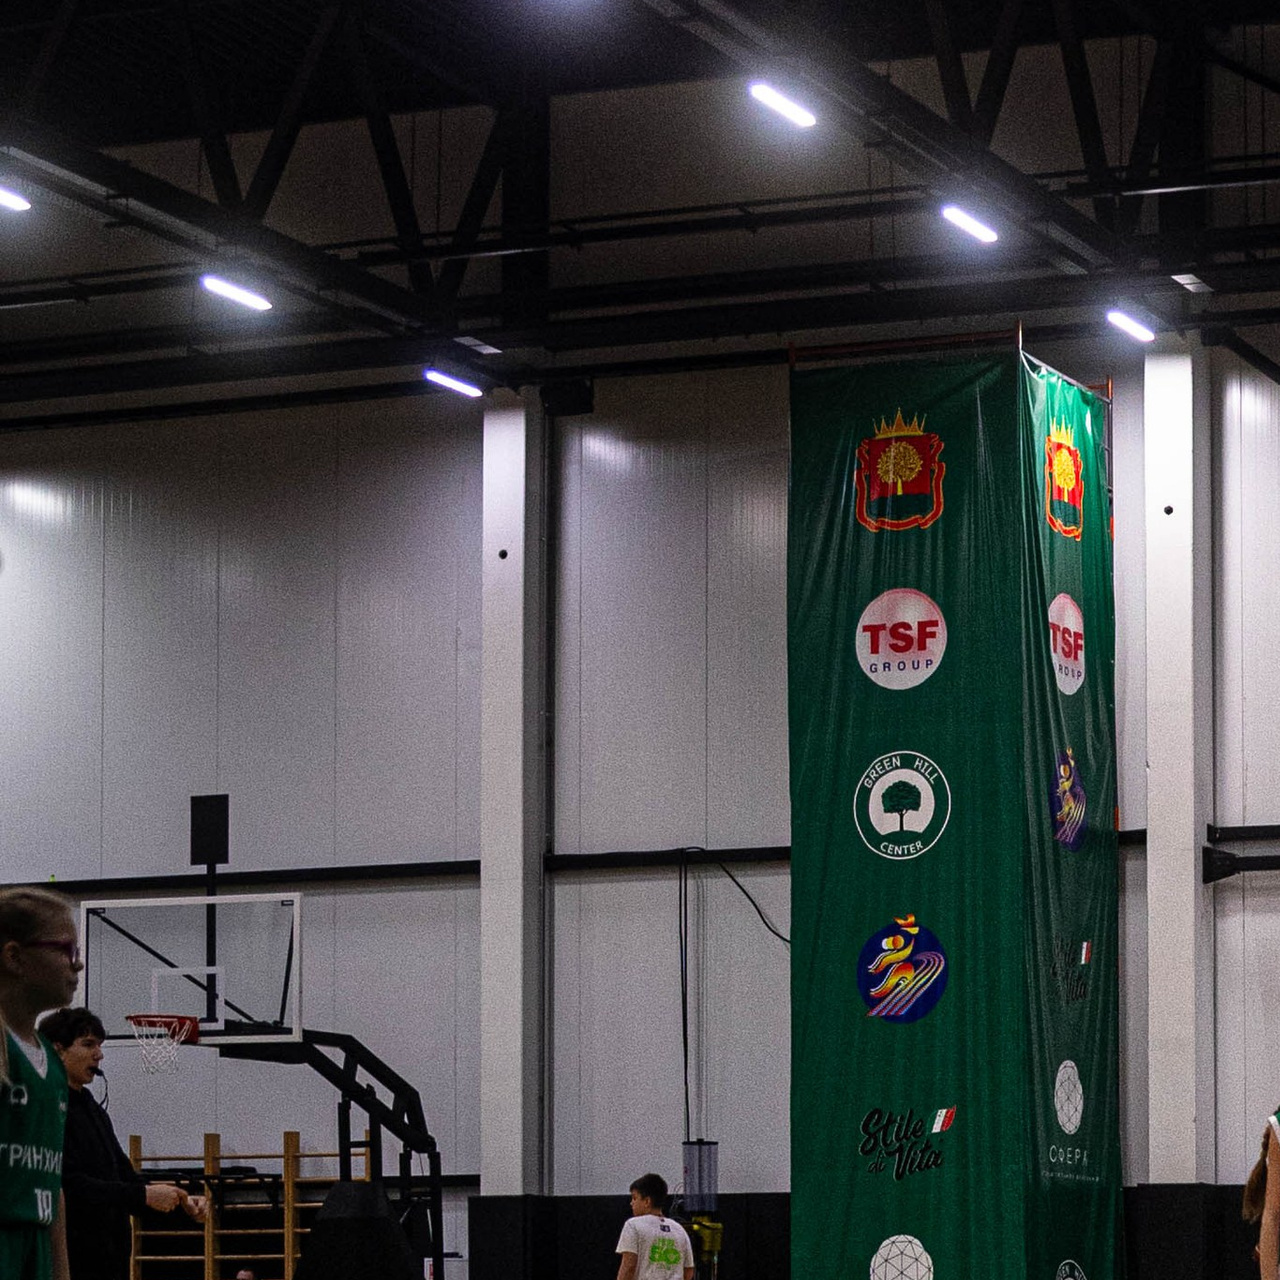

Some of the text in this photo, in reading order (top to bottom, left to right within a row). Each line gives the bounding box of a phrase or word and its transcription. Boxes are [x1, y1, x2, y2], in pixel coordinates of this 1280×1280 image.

[862, 619, 939, 655] TSF
[1049, 622, 1084, 661] TSF
[869, 658, 934, 674] GROUP
[863, 755, 940, 790] GREEN HILL
[879, 840, 924, 856] CENTER
